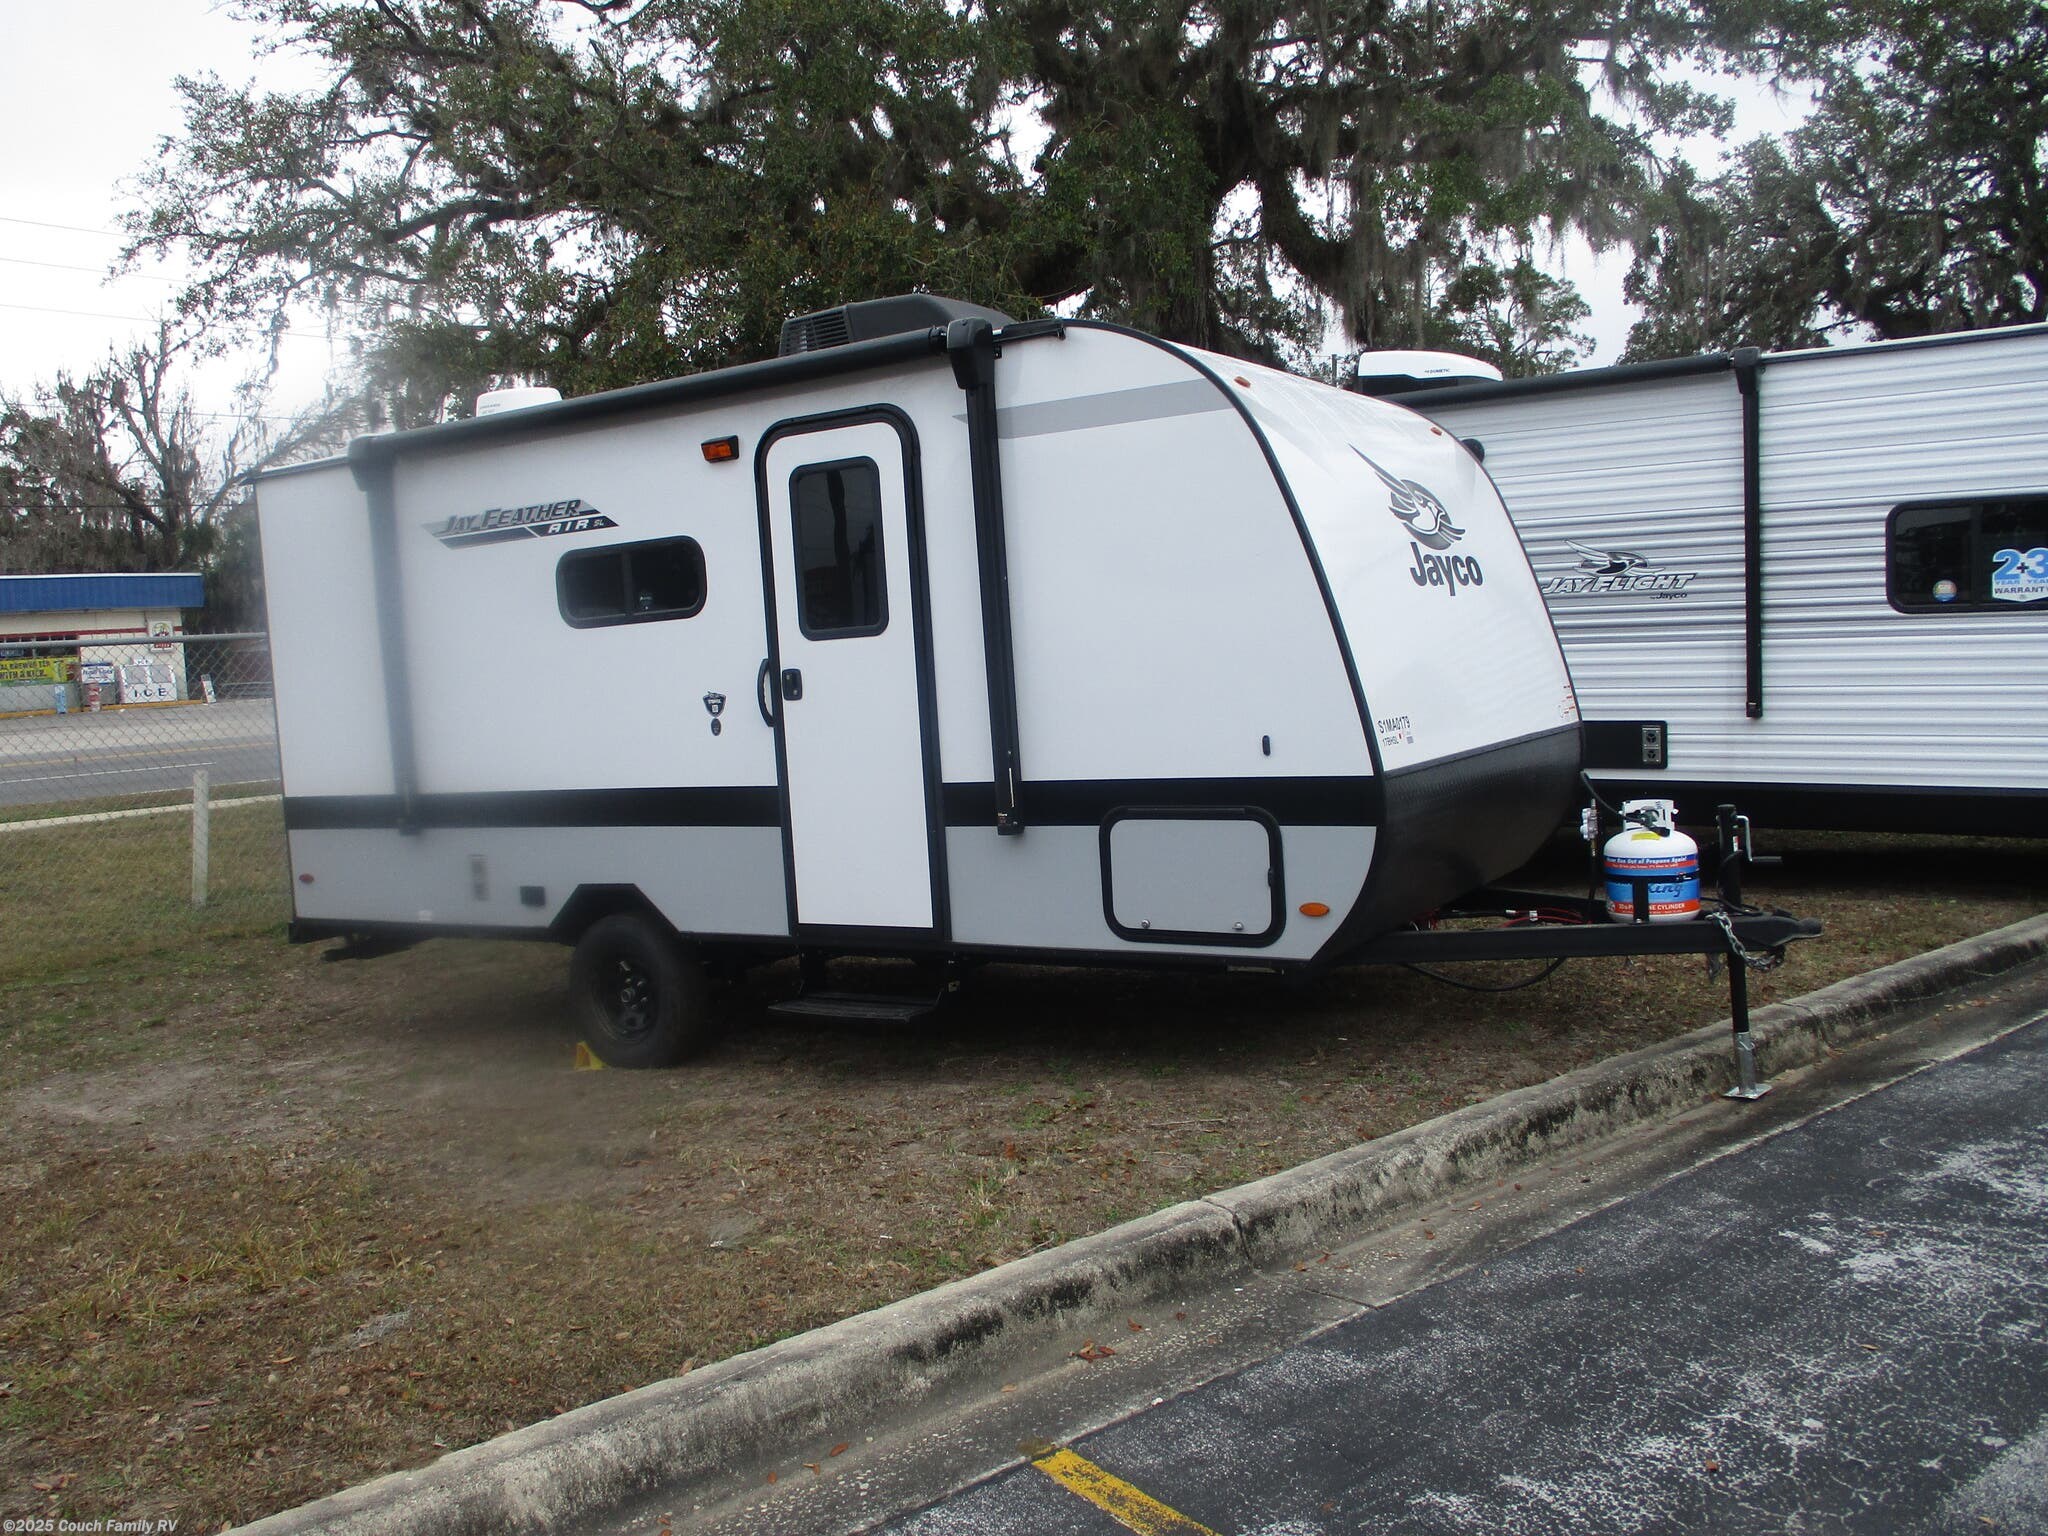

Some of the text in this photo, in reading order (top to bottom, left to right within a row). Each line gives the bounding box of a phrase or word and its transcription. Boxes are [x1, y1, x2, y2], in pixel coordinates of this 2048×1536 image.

[447, 499, 582, 533] JAY FEATHER
[548, 519, 589, 534] AIR
[1409, 541, 1483, 596] Jayco
[1541, 572, 1697, 594] JAY FLIGHT
[1656, 592, 1688, 600] Jayco
[134, 687, 168, 698] ICE
[1657, 902, 1685, 911] CYLINDER
